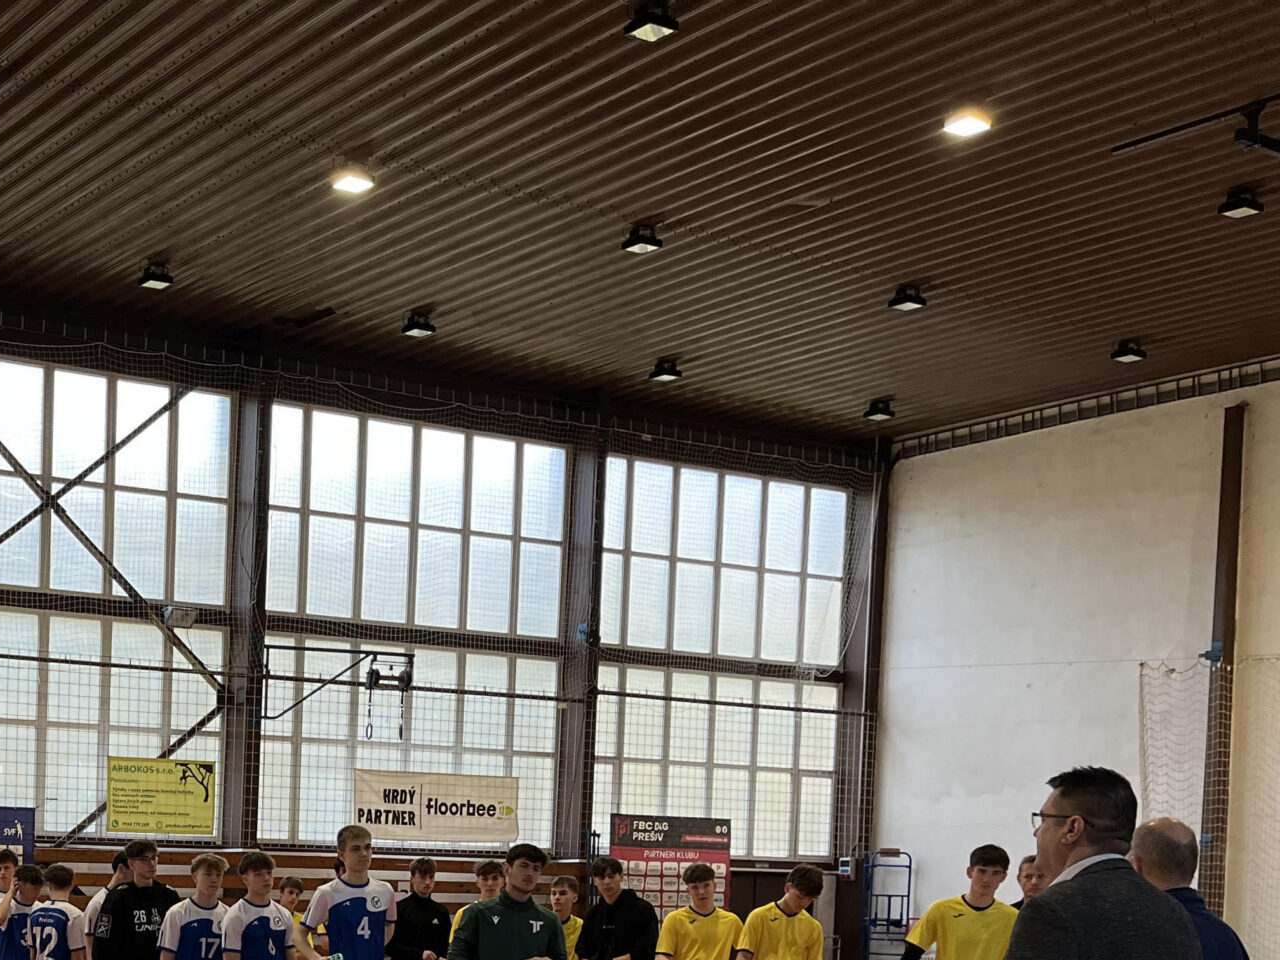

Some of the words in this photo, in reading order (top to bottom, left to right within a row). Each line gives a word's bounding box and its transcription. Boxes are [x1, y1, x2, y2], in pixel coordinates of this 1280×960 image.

[111, 764, 154, 774] ARBOKOS
[382, 785, 417, 805] HRDÝ
[425, 797, 497, 817] floorbee
[357, 808, 417, 826] PARTNER
[632, 820, 653, 831] FBC
[133, 909, 147, 924] 26
[356, 916, 371, 940] 4
[198, 937, 221, 959] 17
